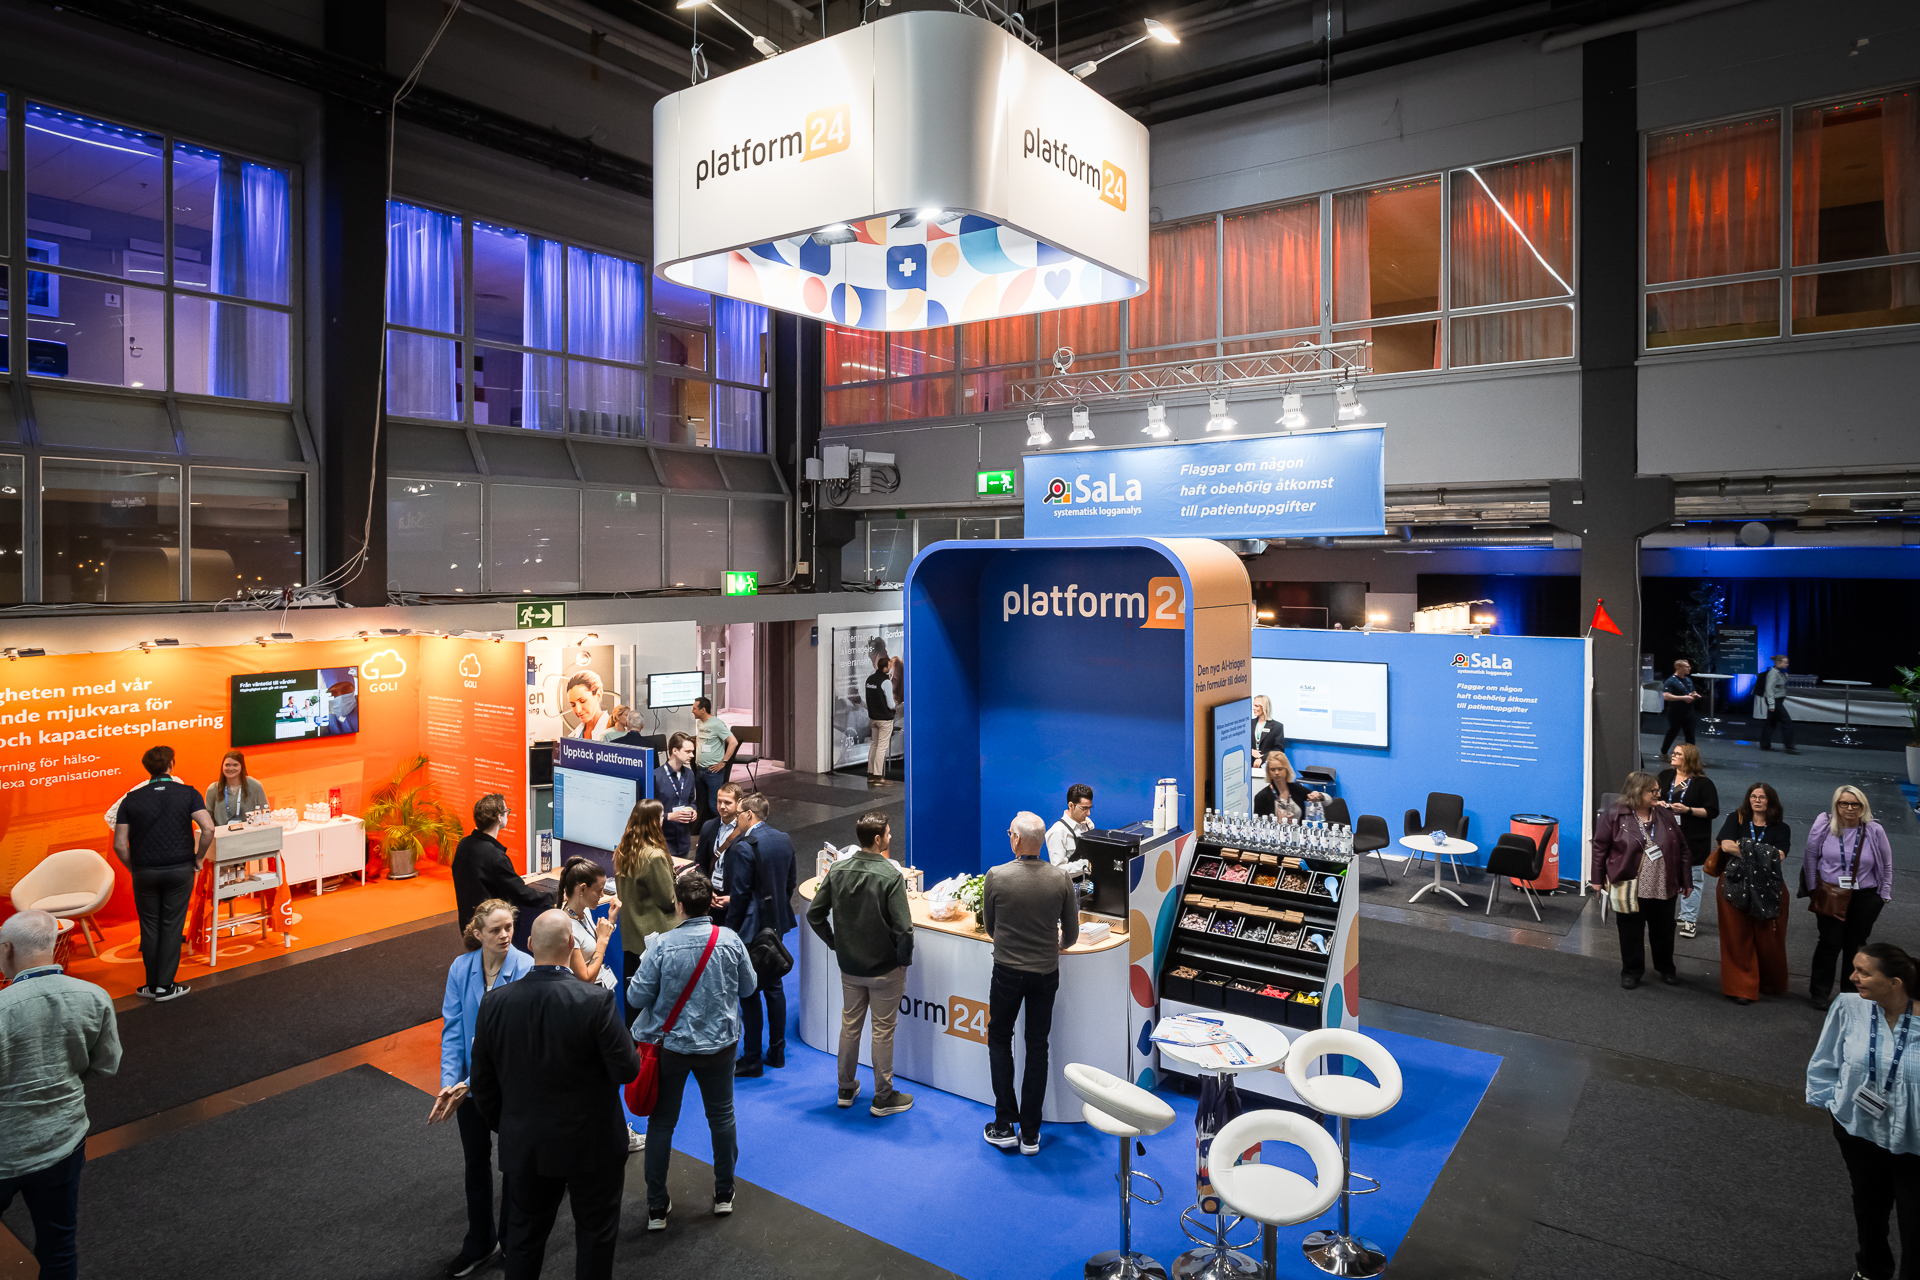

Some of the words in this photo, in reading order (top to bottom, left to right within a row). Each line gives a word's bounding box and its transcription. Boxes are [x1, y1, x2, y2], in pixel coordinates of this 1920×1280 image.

[1180, 463, 1232, 477] Flaggar
[1234, 461, 1256, 472] om
[1259, 457, 1304, 472] någon
[1075, 472, 1142, 504] SaLa
[1180, 484, 1207, 497] haft
[1210, 480, 1272, 494] obehörig
[1275, 476, 1335, 492] åtkomst
[1053, 506, 1098, 519] systematisk
[1099, 505, 1142, 517] logganalys
[1180, 504, 1199, 517] till
[1200, 500, 1317, 518] patientuppgifter
[1197, 664, 1209, 677] Den
[1210, 664, 1220, 676] nya
[1221, 659, 1246, 672] AI-triagen
[1470, 652, 1513, 670] SaLa
[72, 679, 116, 697] med
[121, 677, 153, 692] vår
[369, 681, 398, 693] GOLI
[463, 679, 477, 689] GOLI
[1195, 681, 1206, 693] från
[1234, 673, 1248, 685] dialog
[1456, 682, 1485, 691] Flaggar
[1499, 685, 1523, 693] någon
[1472, 693, 1506, 703] obehörig
[1507, 695, 1539, 704] åtkomst
[0, 708, 41, 725] nde
[47, 700, 141, 723] mjukvara
[145, 697, 173, 712] för
[1467, 703, 1529, 714] patientuppgifter
[38, 714, 225, 746] kapacitetsplanering
[40, 757, 60, 768] för
[63, 754, 101, 765] hälso-
[563, 744, 594, 760] Upptäck
[595, 750, 643, 768] plattformen
[30, 766, 122, 787] organisationer.
[898, 994, 987, 1038] orm24
